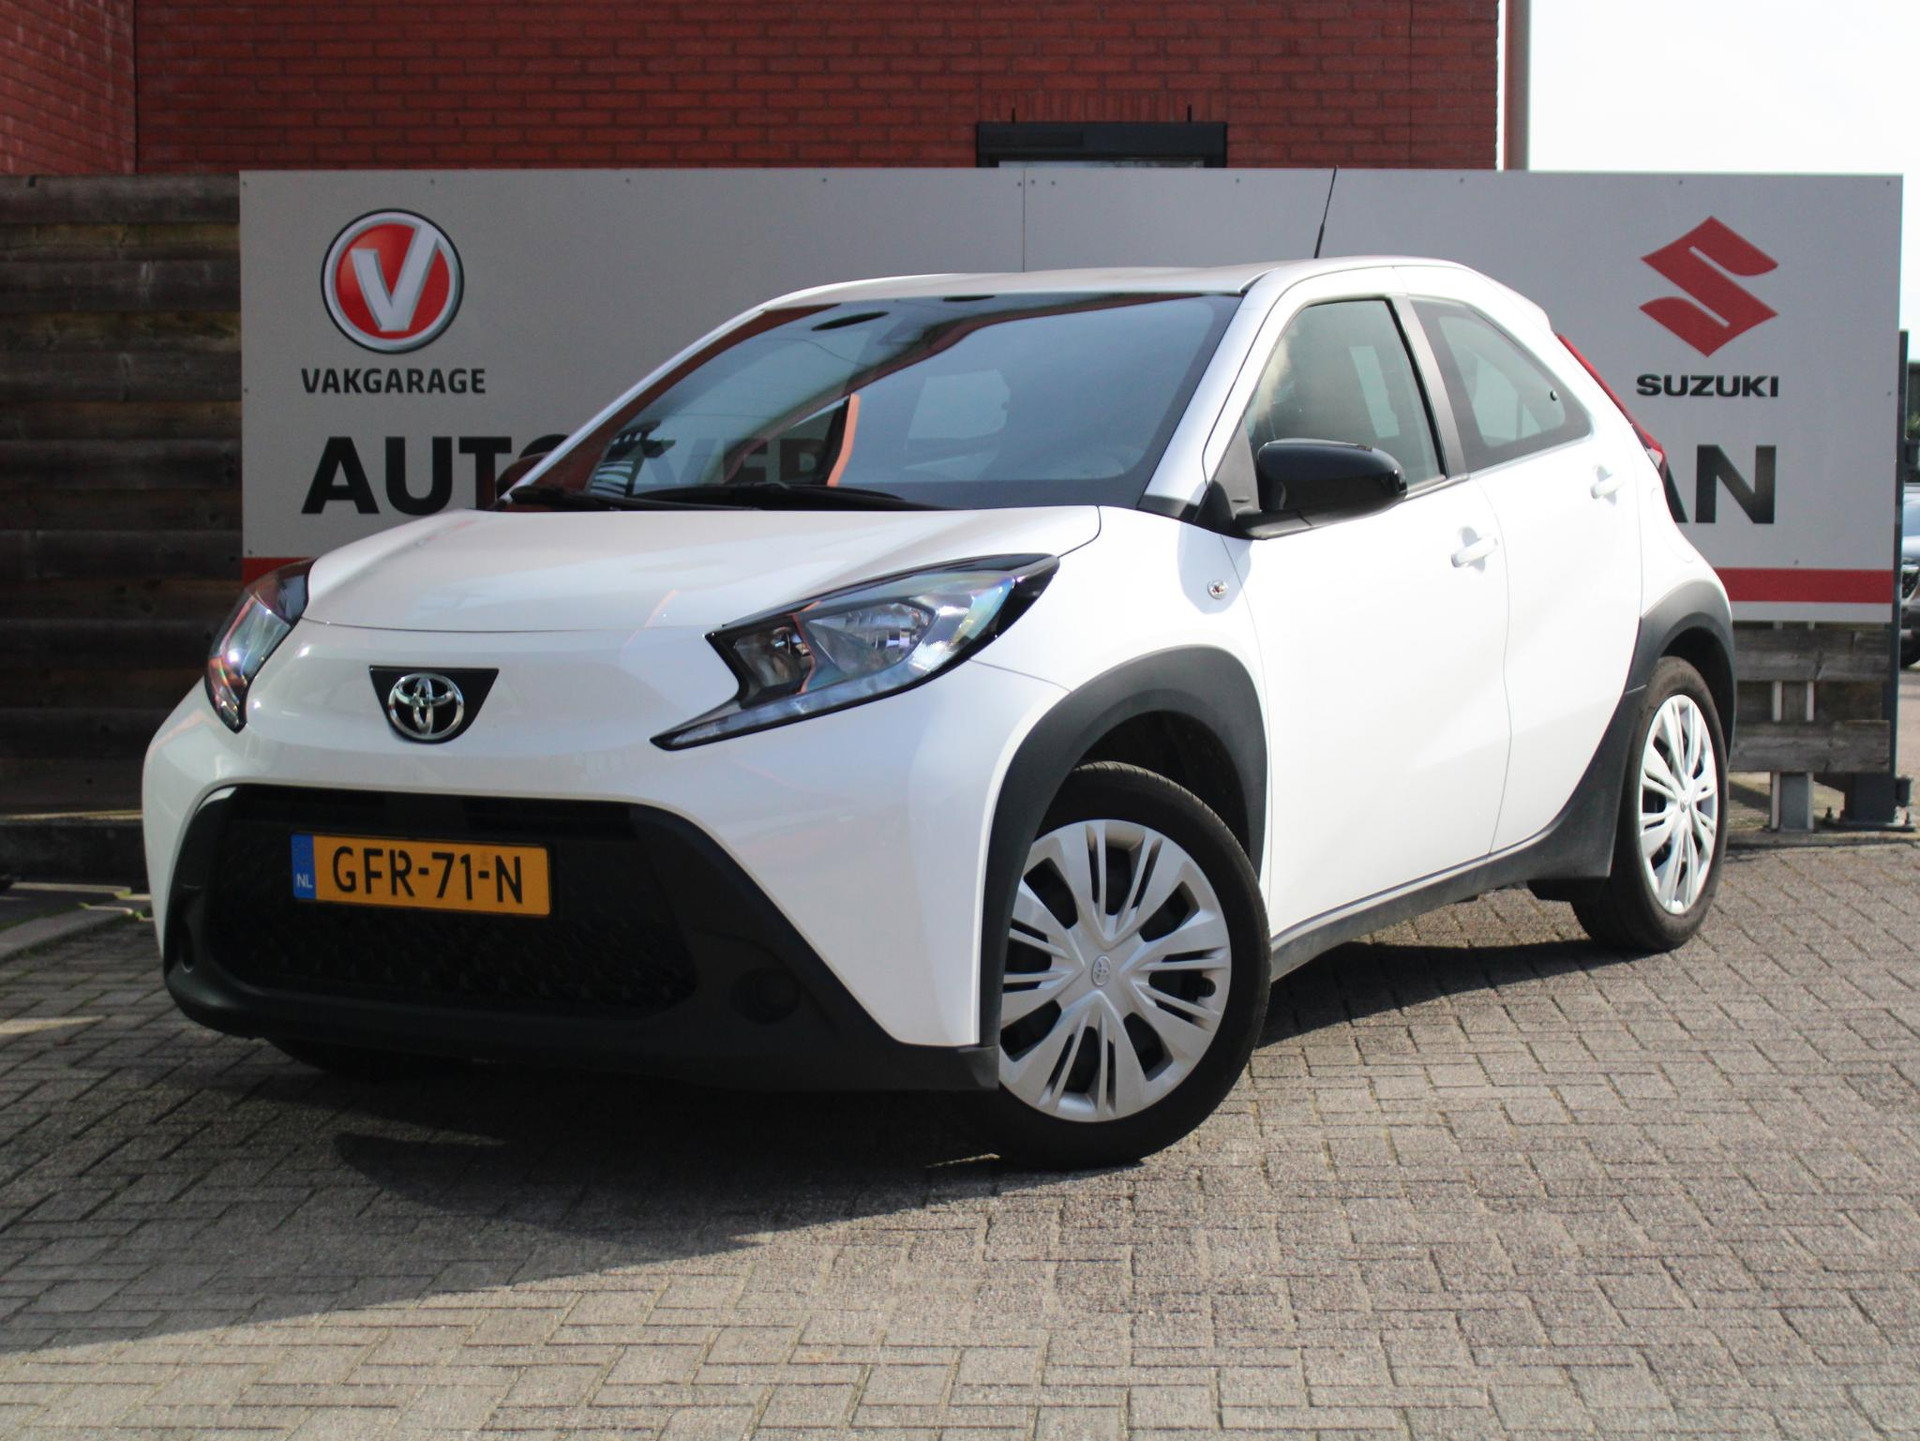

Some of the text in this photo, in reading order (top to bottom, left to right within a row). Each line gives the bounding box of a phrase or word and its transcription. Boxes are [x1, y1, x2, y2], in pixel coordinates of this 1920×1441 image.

[302, 368, 486, 394] VAKGARAGE
[1636, 374, 1778, 397] SUZUKI
[296, 873, 313, 889] NL
[332, 846, 523, 904] GFR-71-N
